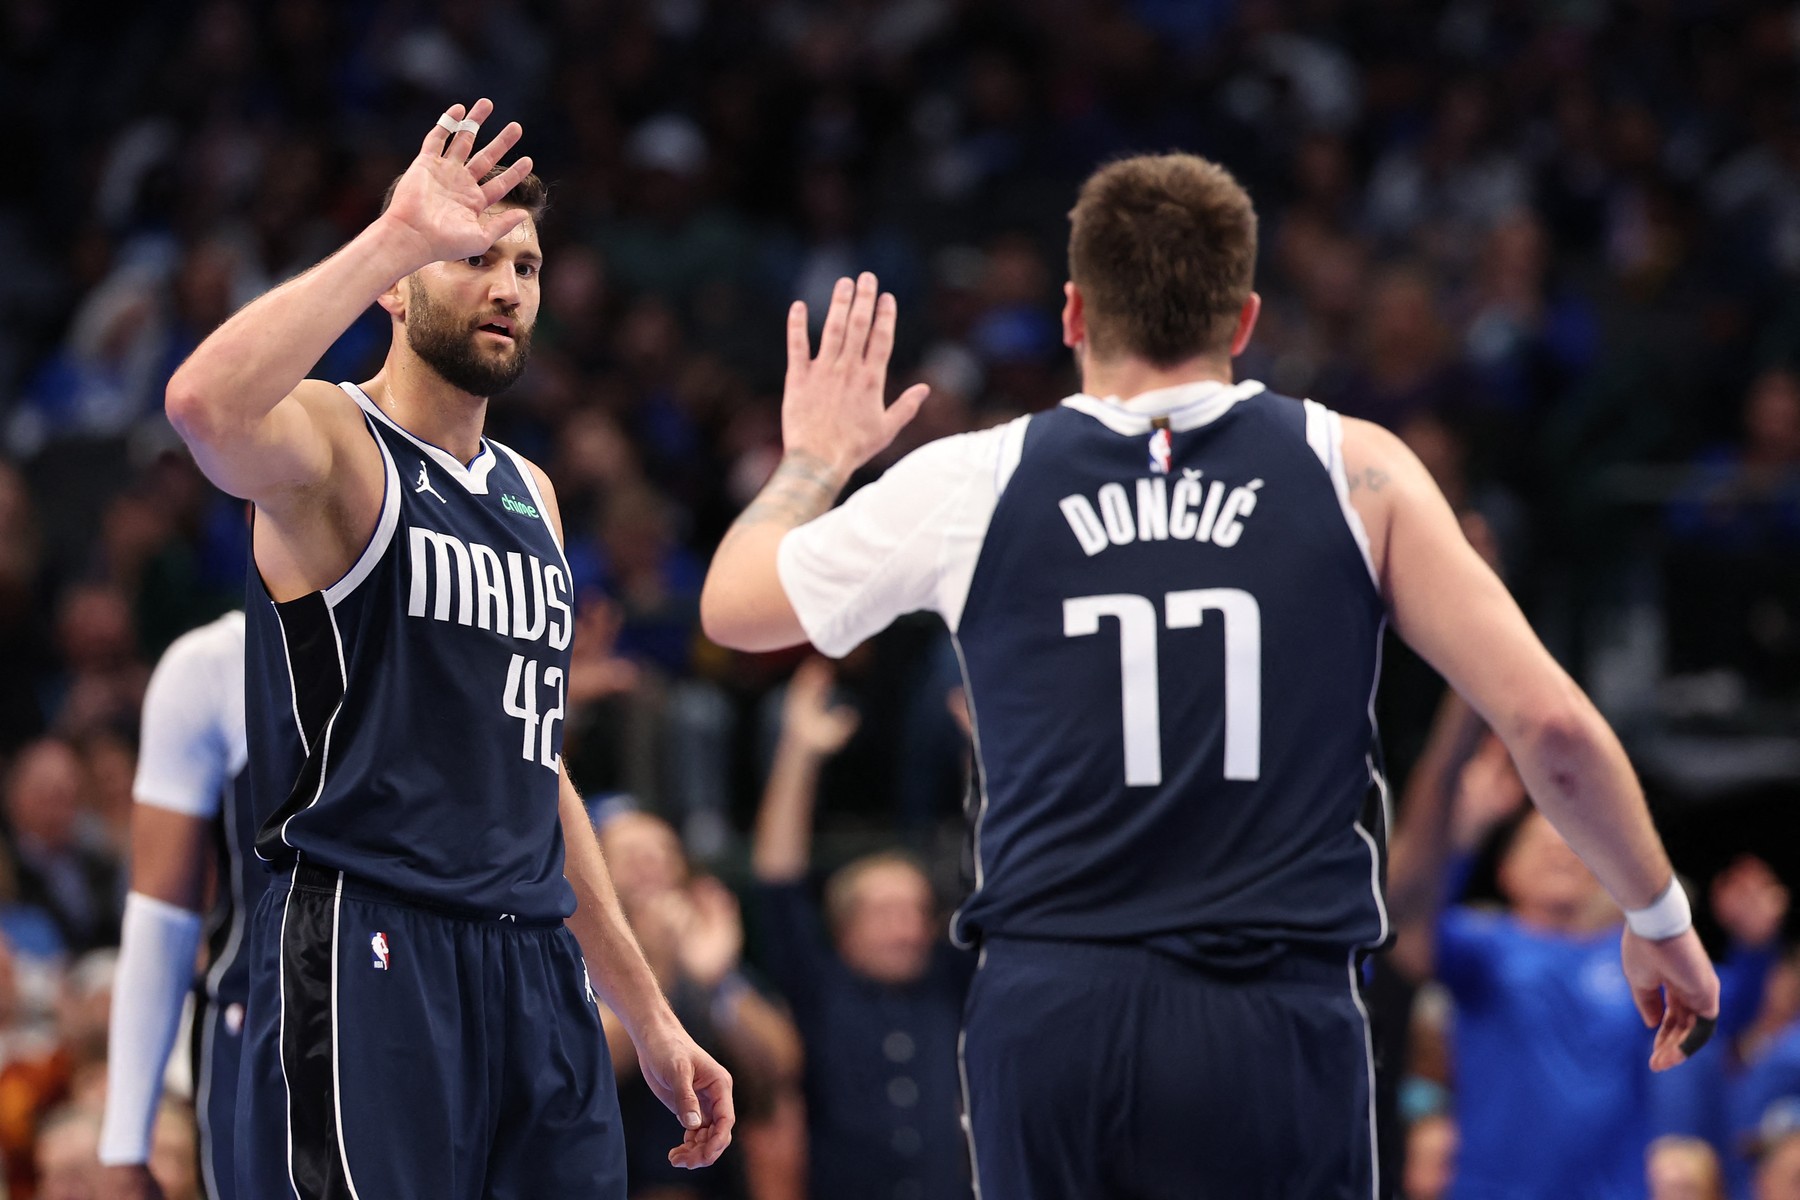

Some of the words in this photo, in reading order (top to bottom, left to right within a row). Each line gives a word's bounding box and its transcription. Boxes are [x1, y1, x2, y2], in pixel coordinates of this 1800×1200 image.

[501, 494, 539, 518] chime
[1059, 467, 1265, 557] DONČIĆ
[408, 527, 572, 651] MAVS
[503, 653, 564, 774] 42
[1063, 587, 1261, 787] 77
